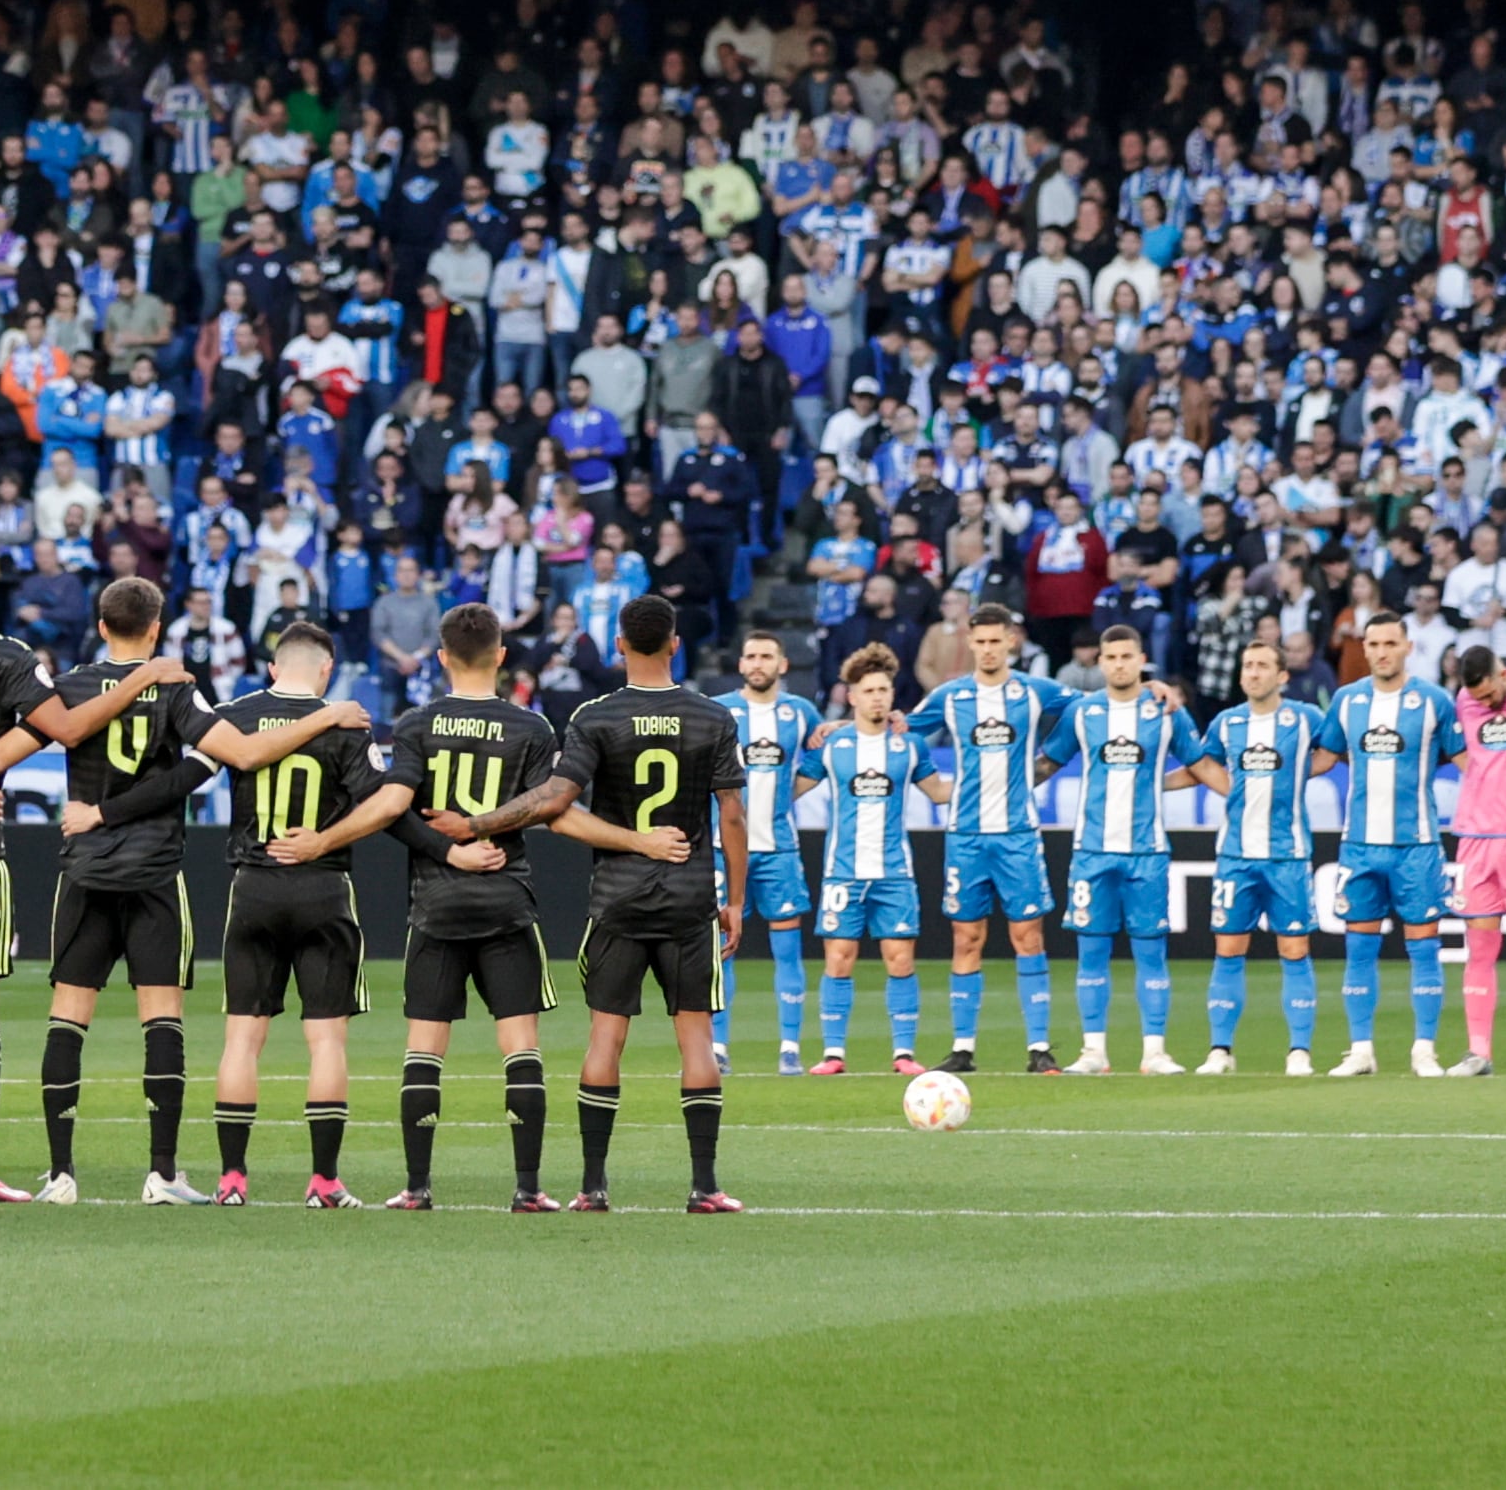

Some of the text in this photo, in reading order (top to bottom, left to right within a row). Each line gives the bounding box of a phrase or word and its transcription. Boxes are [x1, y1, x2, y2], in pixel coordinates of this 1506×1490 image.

[432, 713, 505, 742] ÁLVARO M.
[632, 716, 681, 736] TOBIAS
[428, 749, 503, 818] 14
[634, 748, 679, 835] 2
[256, 754, 322, 843] 10
[945, 866, 961, 895] 5
[1072, 879, 1092, 908] 8
[1211, 879, 1235, 908] 21
[1335, 865, 1354, 895] 7
[821, 884, 850, 913] 10
